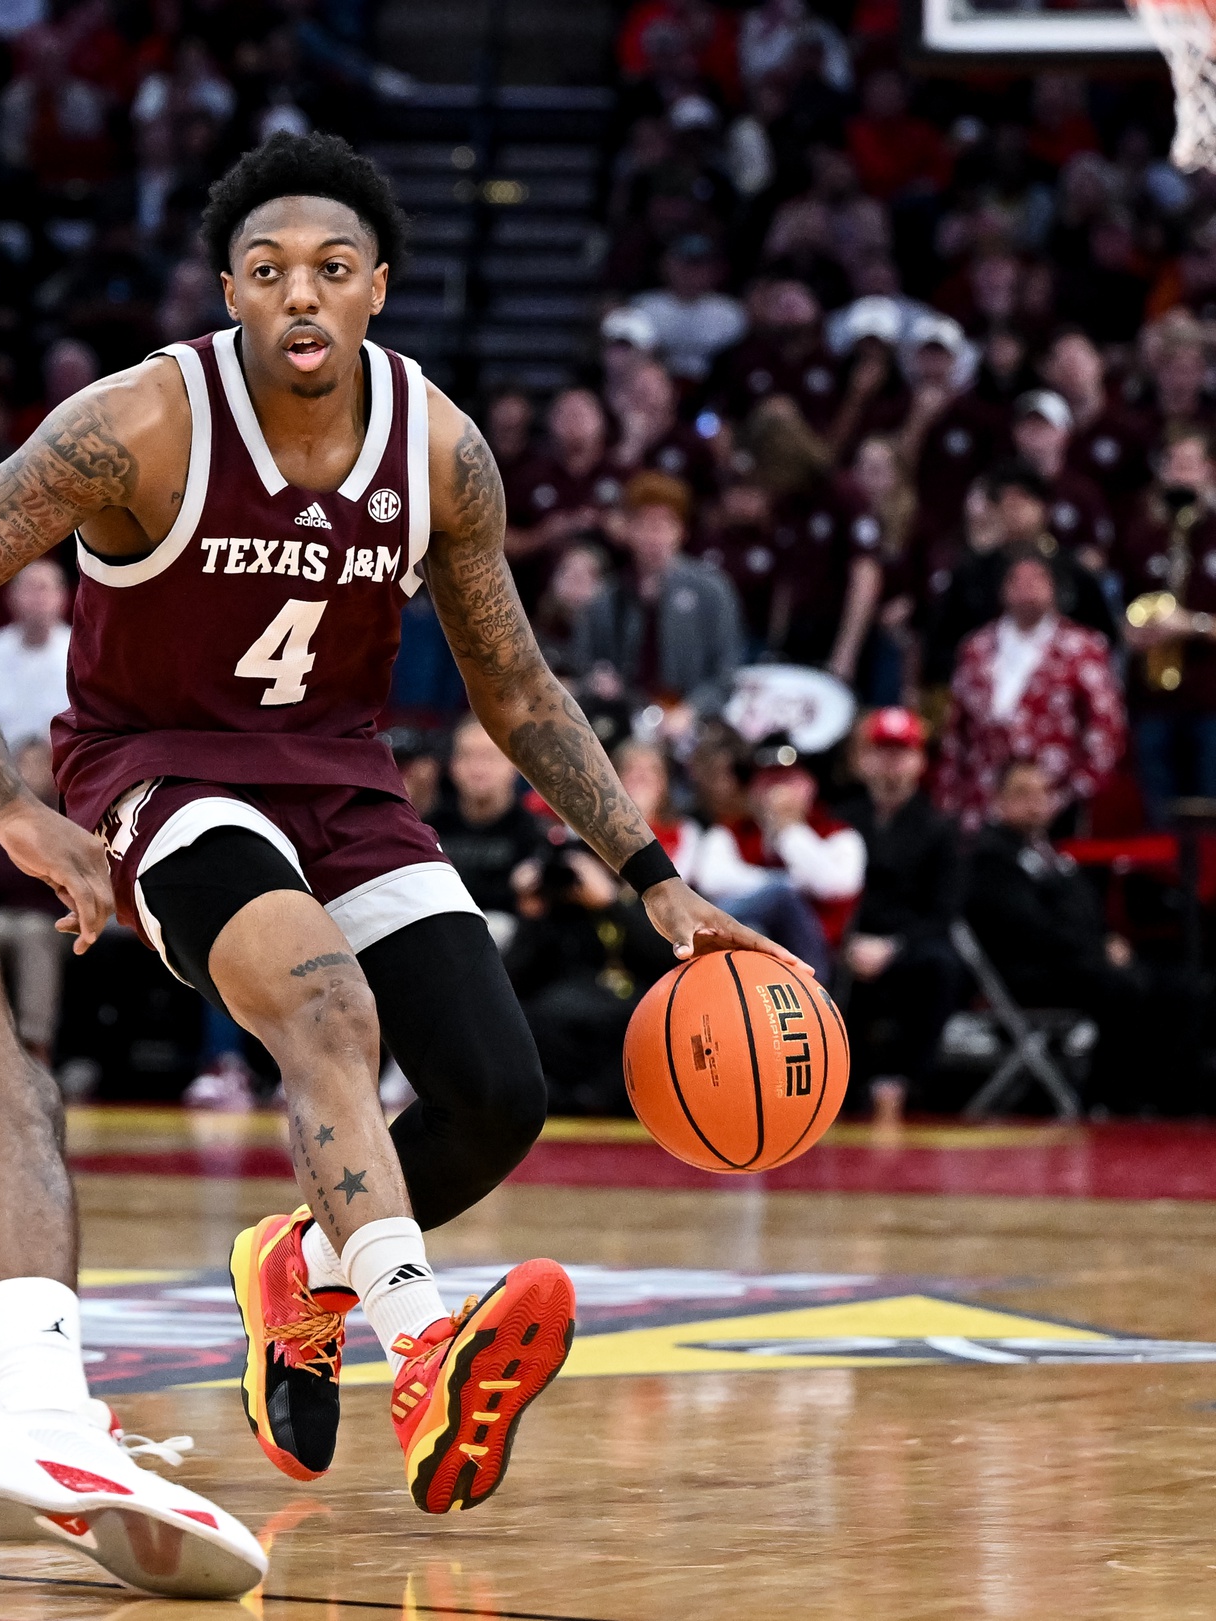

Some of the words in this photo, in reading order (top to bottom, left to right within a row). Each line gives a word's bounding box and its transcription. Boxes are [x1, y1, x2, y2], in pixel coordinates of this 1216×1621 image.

[294, 516, 332, 530] adidas
[370, 494, 399, 521] SEC
[200, 537, 329, 582] TEXAS
[337, 544, 401, 584] A&M
[234, 599, 328, 705] 4
[755, 985, 784, 1098] CHAMPIONIP
[766, 984, 811, 1097] ELITE
